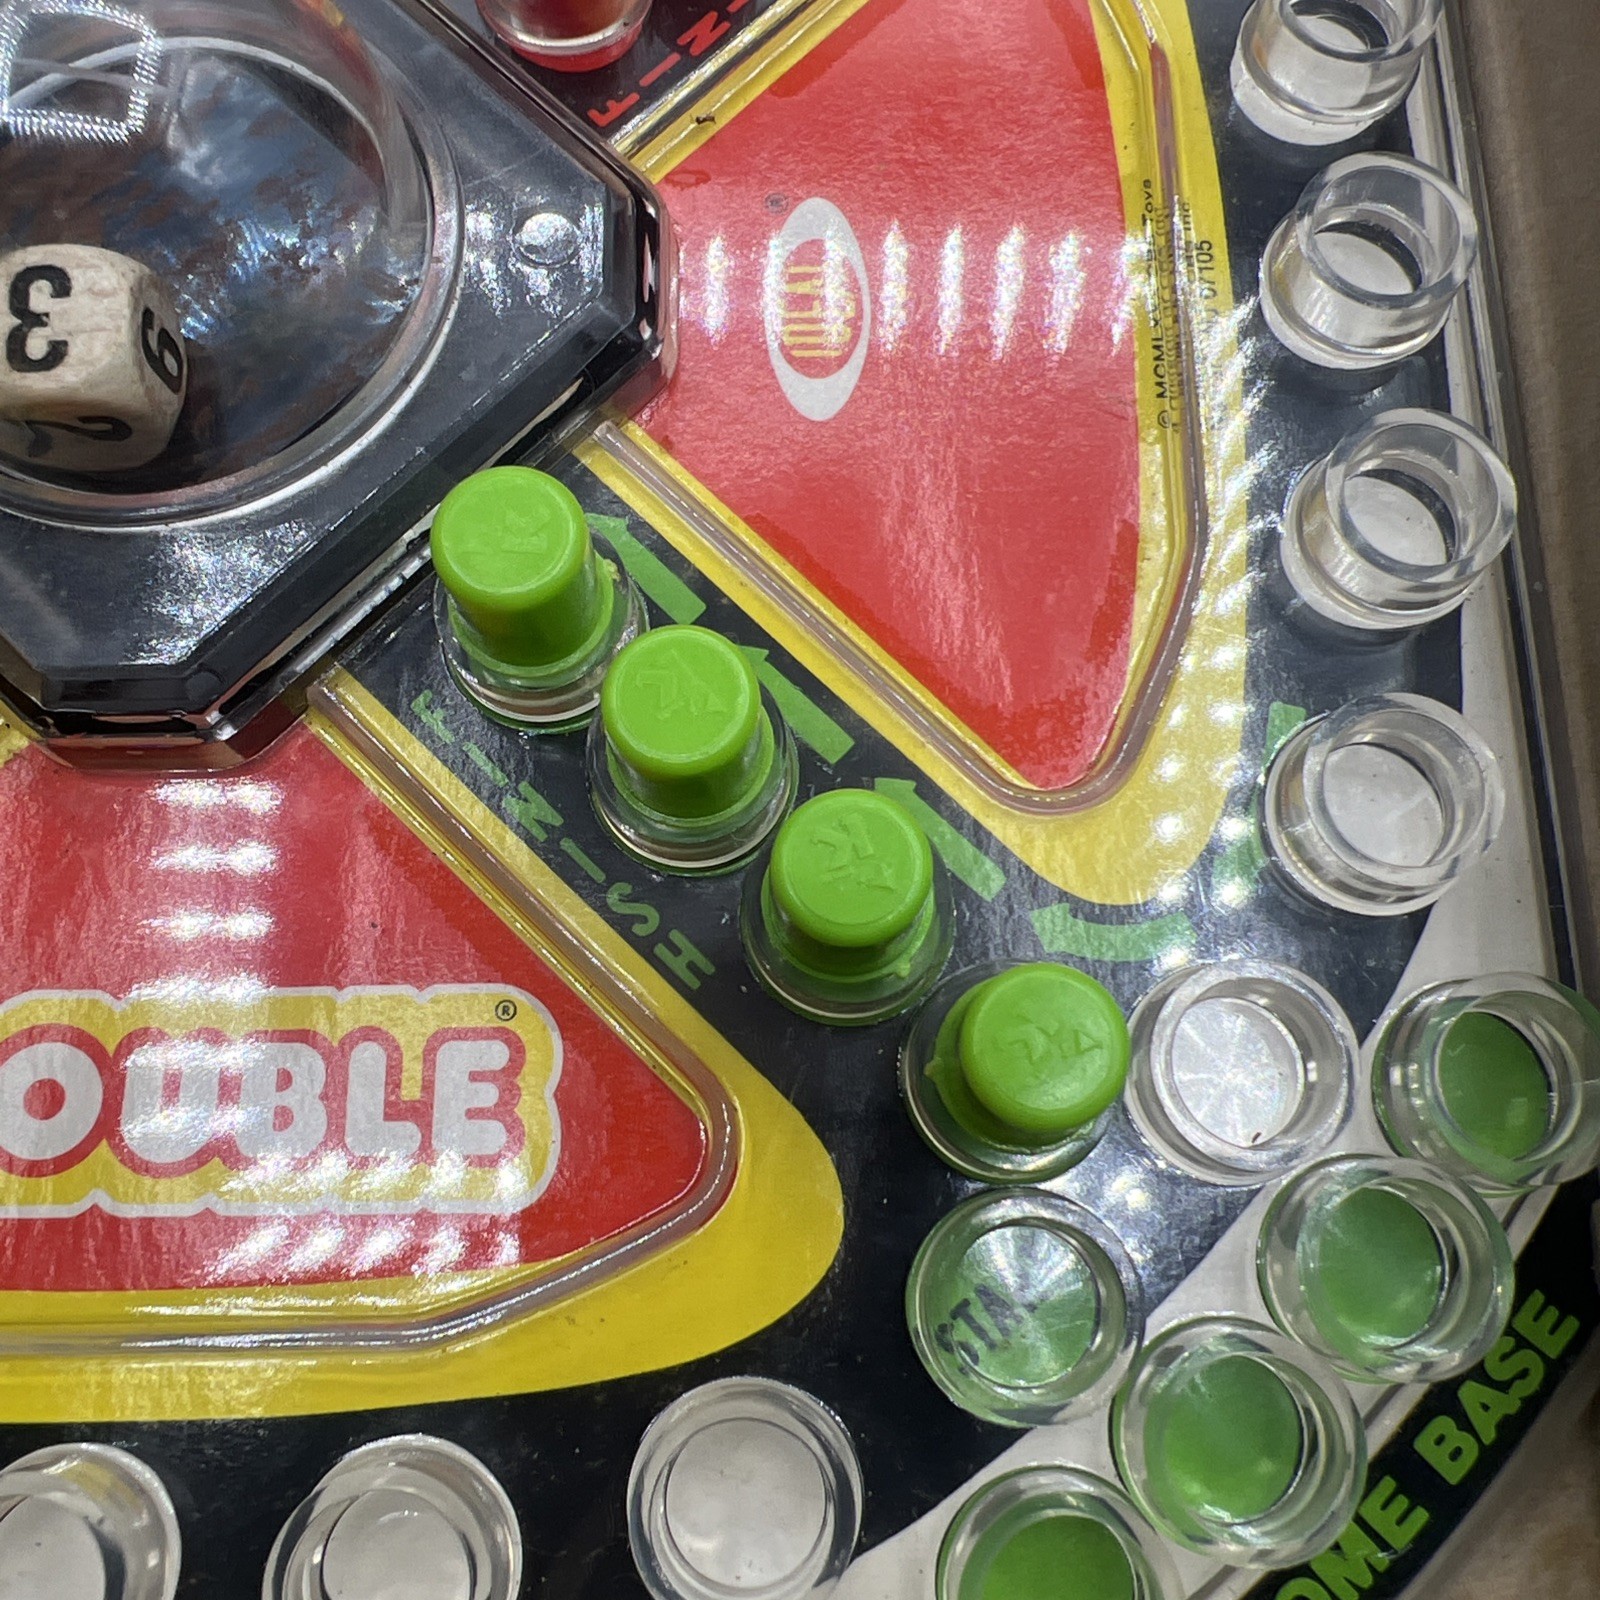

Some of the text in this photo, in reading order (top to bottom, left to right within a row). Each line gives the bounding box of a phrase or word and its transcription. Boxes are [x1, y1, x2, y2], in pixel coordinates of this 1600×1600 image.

[6, 264, 72, 372] 3
[1195, 240, 1218, 299] 07105
[410, 689, 716, 990] FINISH
[1412, 1289, 1580, 1486] BASE
